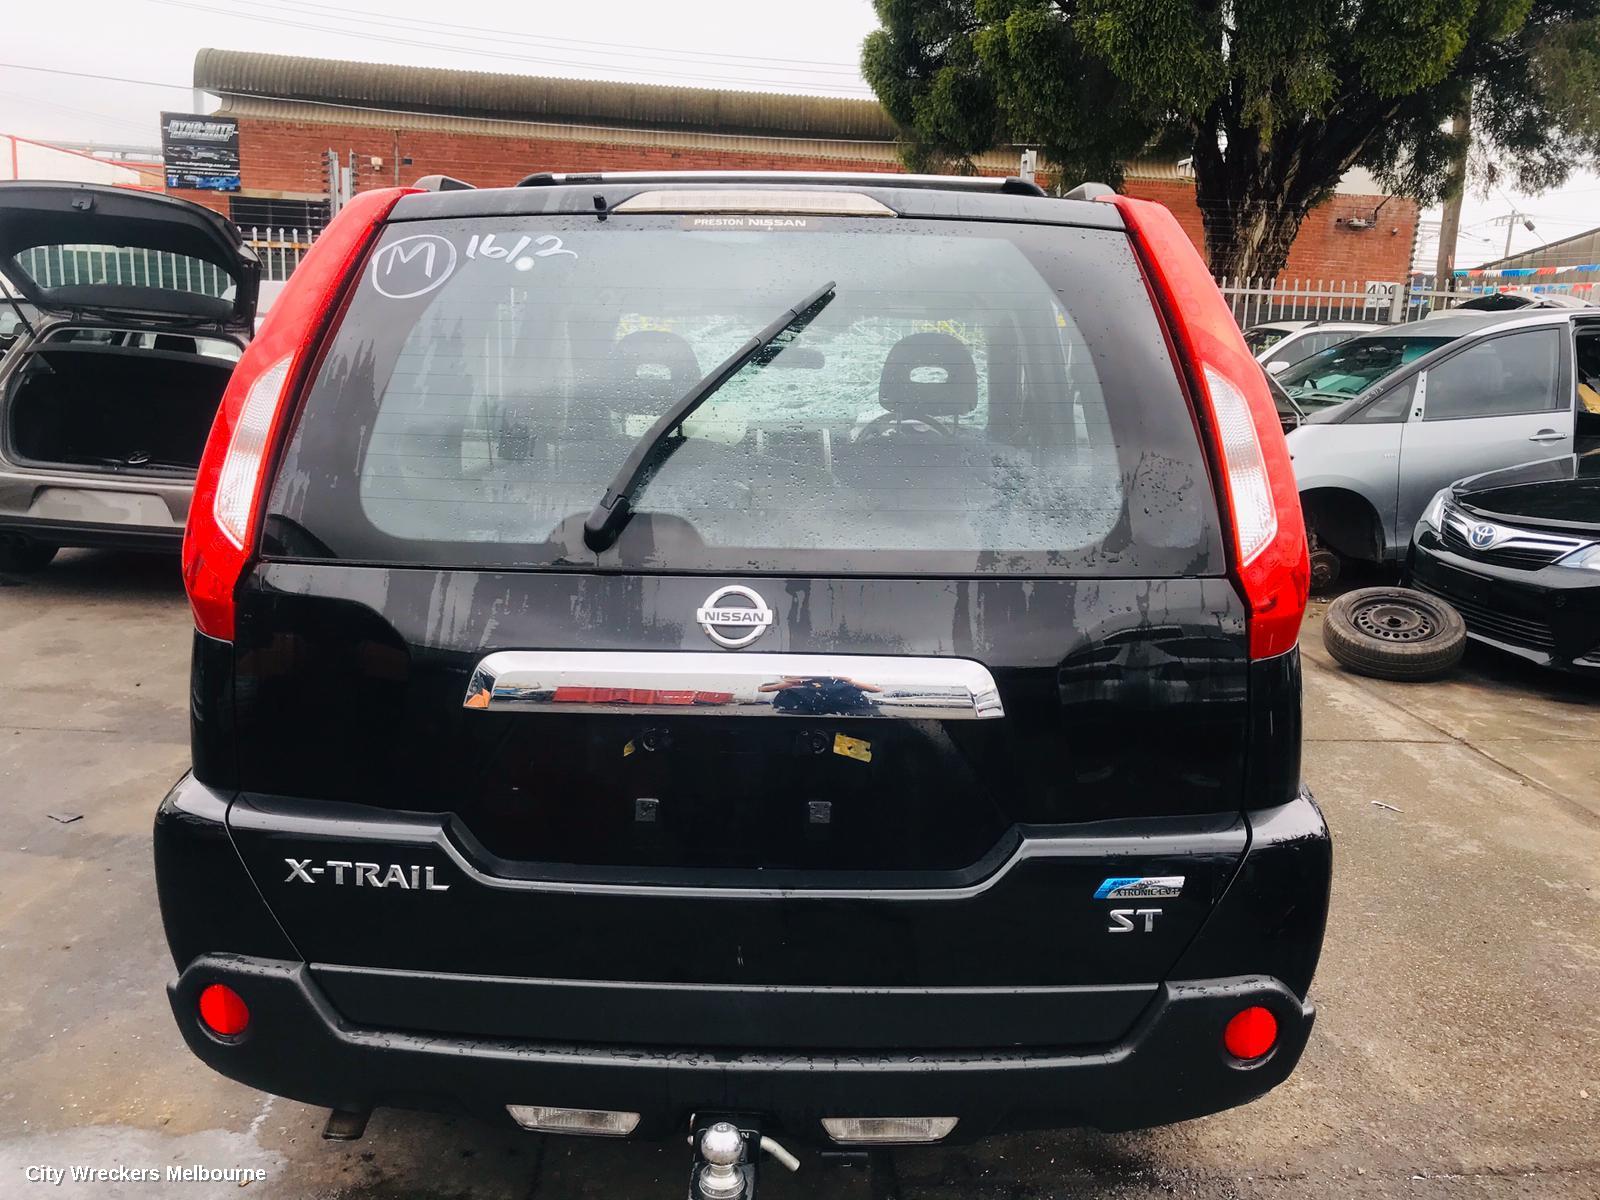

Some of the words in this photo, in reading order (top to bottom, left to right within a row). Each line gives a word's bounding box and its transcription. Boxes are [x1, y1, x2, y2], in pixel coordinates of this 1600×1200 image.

[694, 218, 744, 226] PRESTON
[748, 218, 807, 227] NISSAN
[704, 611, 765, 622] NISSAN
[284, 858, 450, 891] X-TRAIL
[1115, 888, 1158, 897] XTRONIC
[1108, 908, 1163, 932] ST
